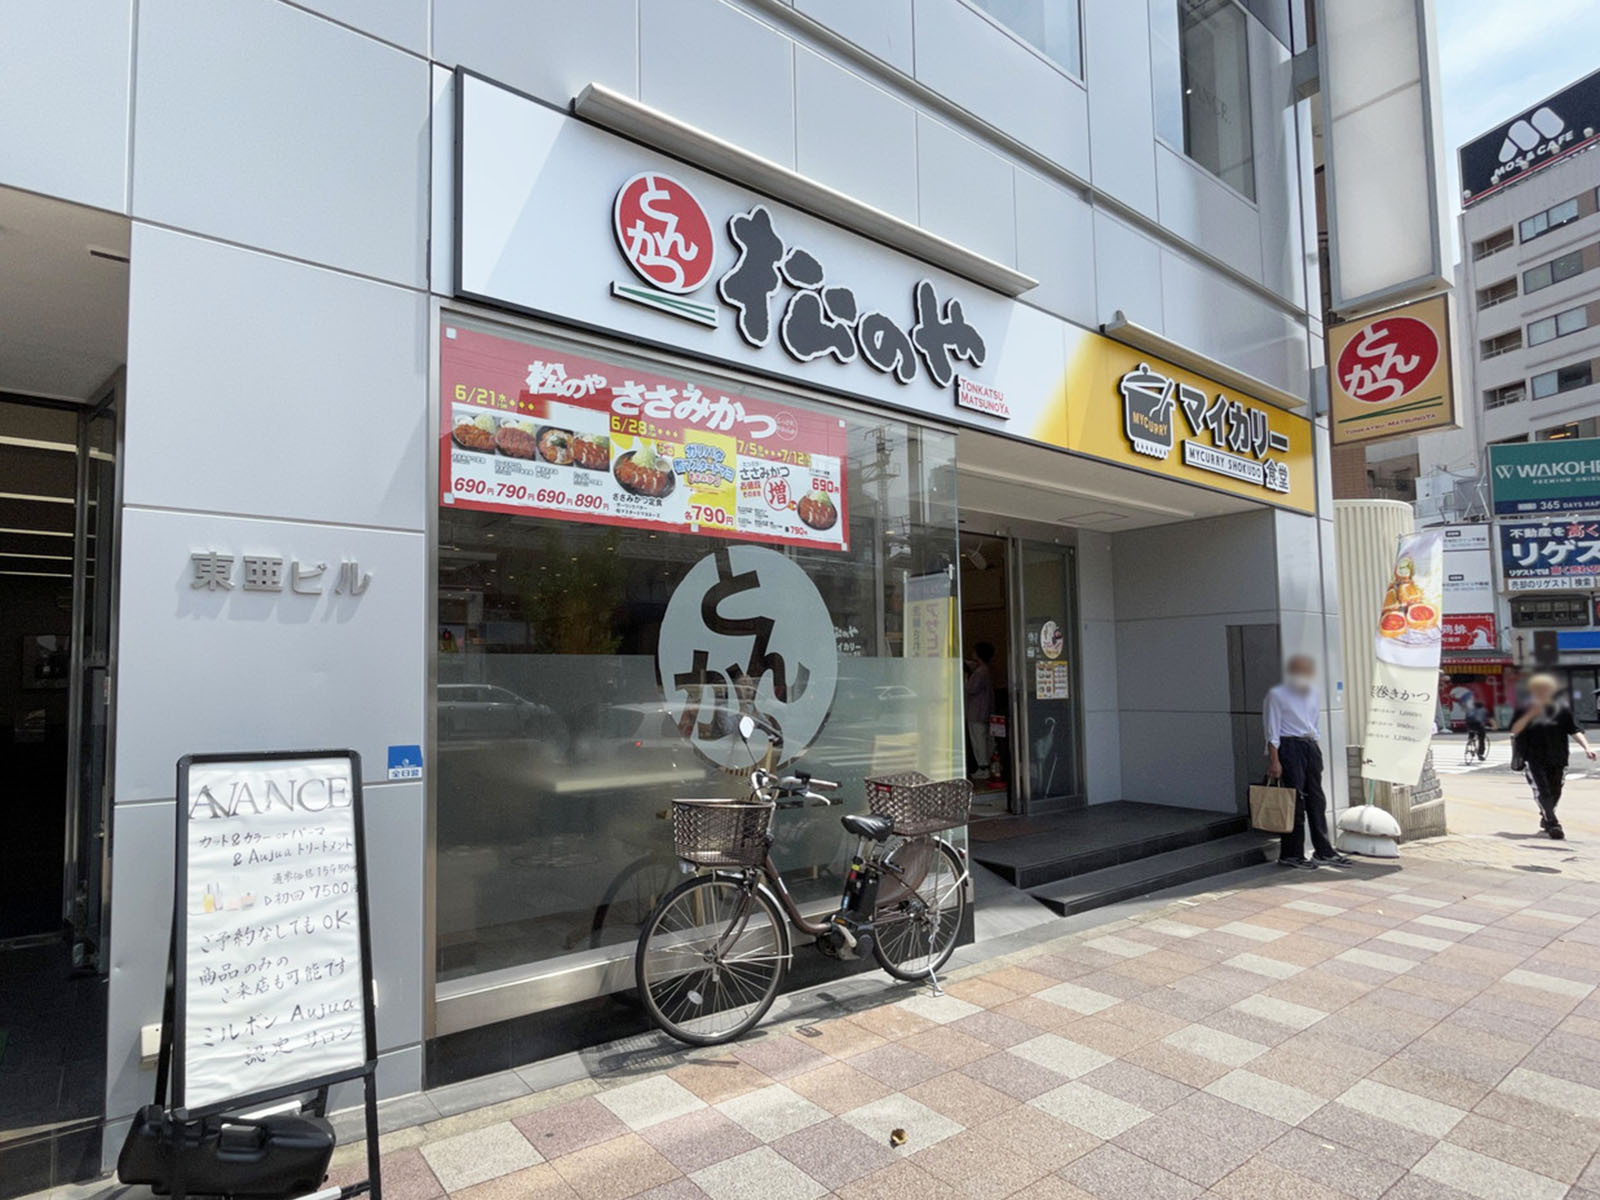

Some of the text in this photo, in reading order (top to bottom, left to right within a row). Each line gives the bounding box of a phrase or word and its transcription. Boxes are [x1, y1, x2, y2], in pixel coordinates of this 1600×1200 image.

[627, 176, 699, 288] とんかつ
[525, 360, 608, 399] 松のや
[1344, 324, 1421, 402] とんかつ
[960, 378, 1004, 402] TONKATSU
[960, 391, 1010, 415] MATSUNOYA
[610, 380, 778, 440] ささみかつ
[1132, 411, 1169, 436] MYCURRY
[1177, 382, 1290, 460] マイカリー
[1188, 446, 1263, 480] MYCURRY SHOKUDO
[1263, 458, 1290, 493] 食堂
[1516, 460, 1600, 478] WAKOH
[767, 480, 787, 505] 増
[1540, 500, 1561, 510] 365
[190, 551, 373, 597] 東亜ビル
[188, 777, 353, 820] AVANCE
[203, 998, 354, 1047] ミルボン Aujua
